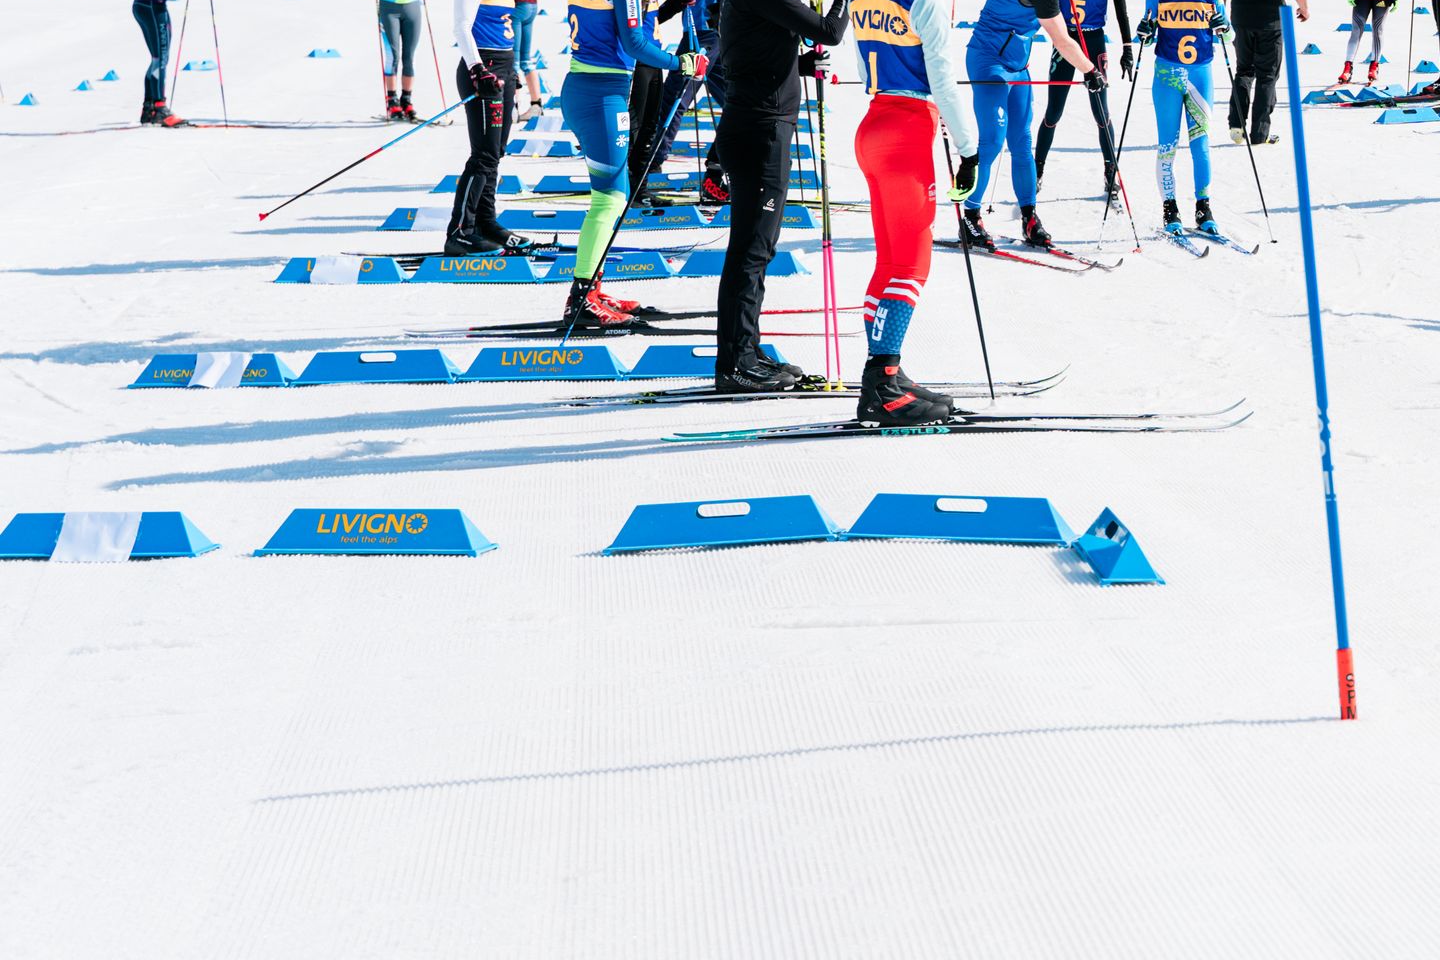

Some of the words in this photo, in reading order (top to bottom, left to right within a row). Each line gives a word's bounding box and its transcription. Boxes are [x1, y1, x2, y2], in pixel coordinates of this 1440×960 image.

[1070, 0, 1086, 25] 5
[500, 13, 515, 40] 3
[570, 13, 580, 51] 2
[1177, 35, 1198, 65] 6
[868, 51, 883, 94] 1
[1162, 162, 1174, 191] FÉCLAZ
[659, 215, 692, 224] LIVIGNO
[439, 258, 507, 272] LIVIGNO
[616, 263, 654, 272] LIVIGNO
[872, 306, 889, 342] CZE
[501, 348, 584, 367] LIVIGNO
[316, 513, 428, 534] LIVIGNO
[340, 535, 359, 544] feel
[361, 535, 376, 544] the
[379, 535, 398, 545] alps
